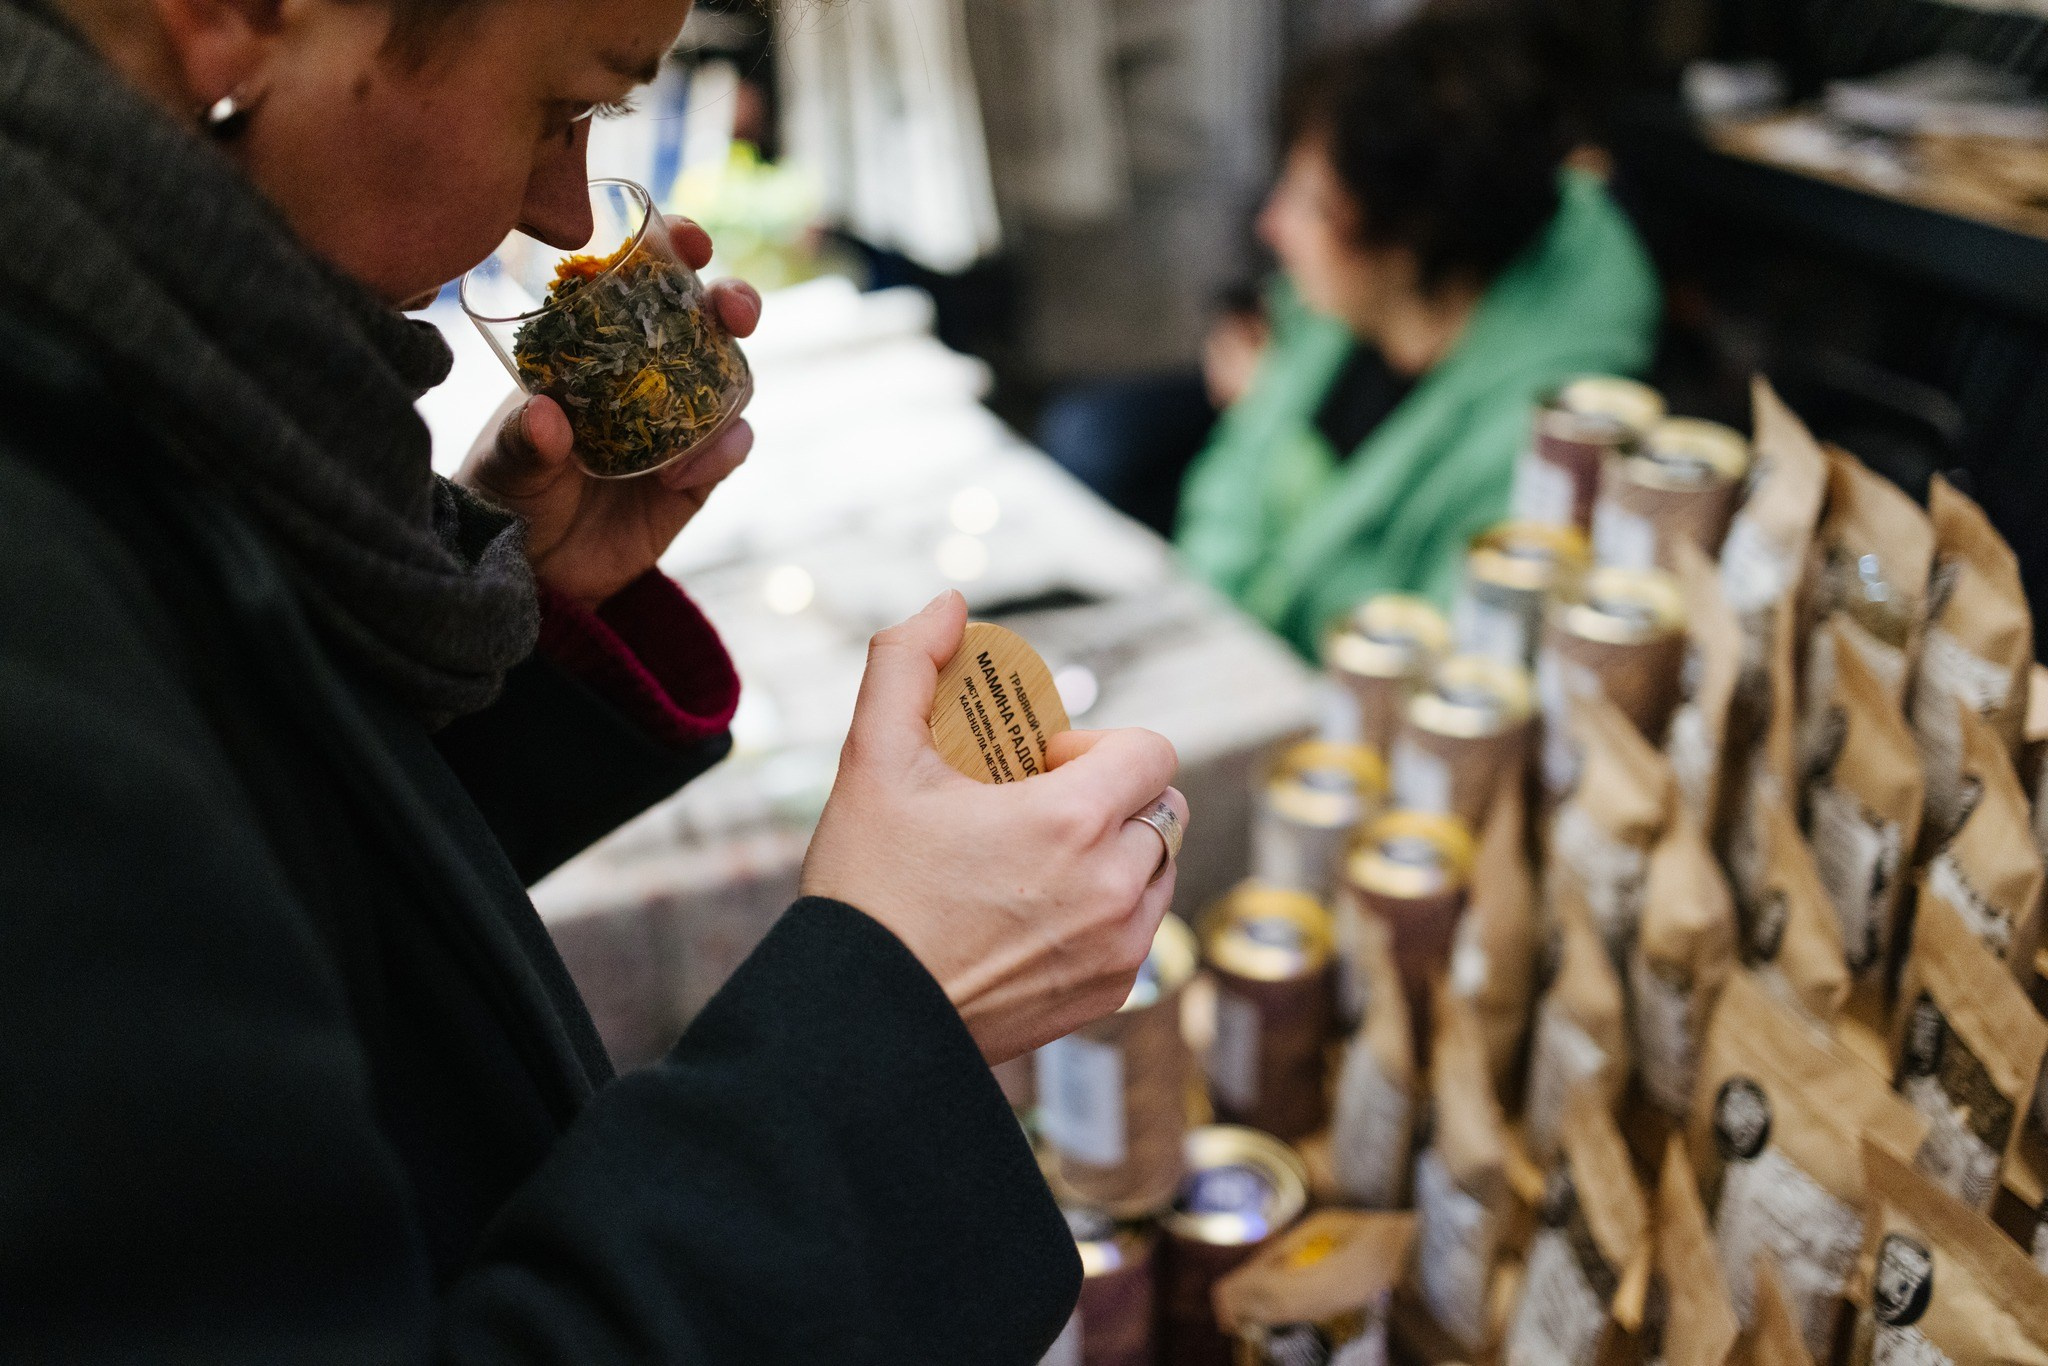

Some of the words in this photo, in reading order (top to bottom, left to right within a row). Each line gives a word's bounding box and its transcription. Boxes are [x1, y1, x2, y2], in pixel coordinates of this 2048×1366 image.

[963, 676, 979, 699] ЛИСТ
[976, 651, 1015, 726] МАМИНА
[1009, 670, 1040, 731] ТРАВЯНОЙ
[983, 752, 1004, 784] МЕЛИС
